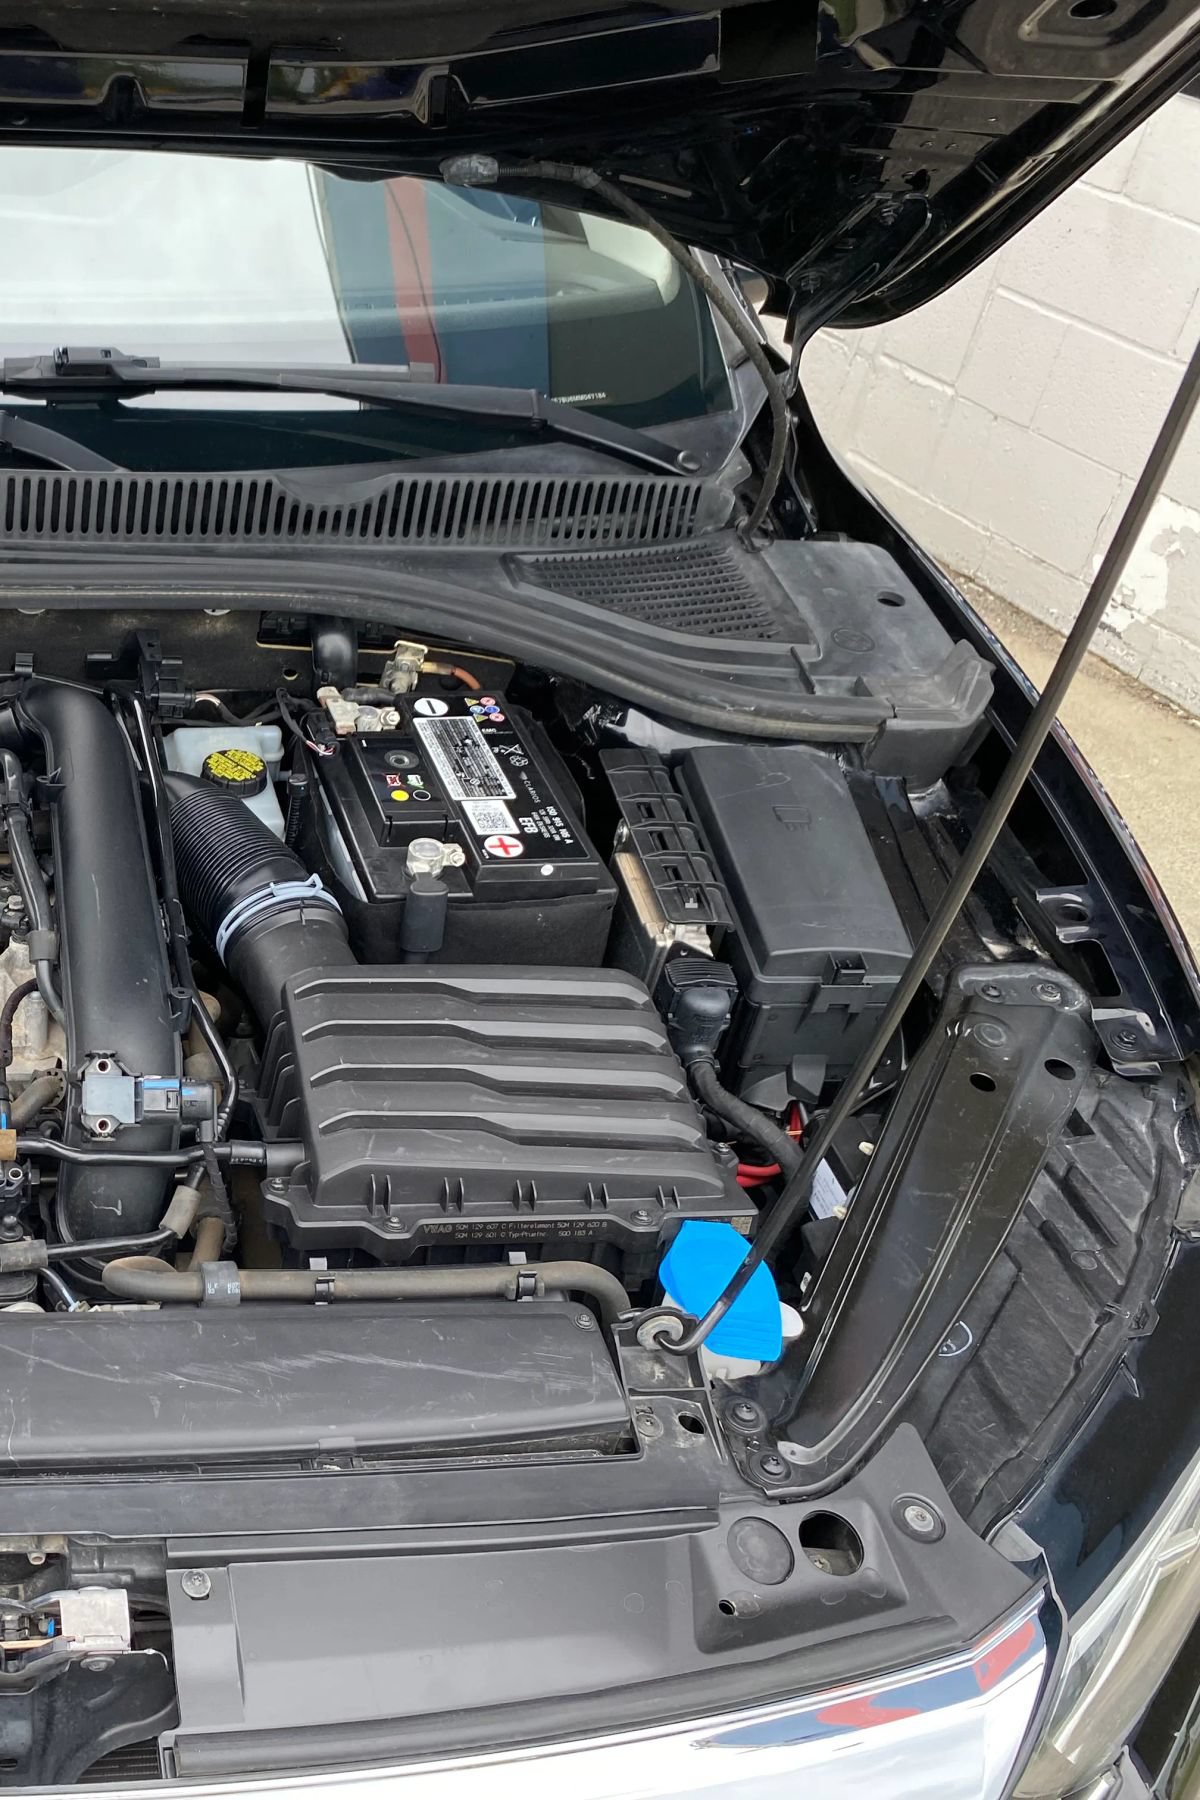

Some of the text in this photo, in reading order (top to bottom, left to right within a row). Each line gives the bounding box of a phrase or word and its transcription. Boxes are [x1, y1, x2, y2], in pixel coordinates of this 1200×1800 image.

[524, 780, 541, 803] CLARIOS
[518, 817, 539, 833] EFB
[509, 1222, 555, 1230] Filterelement
[471, 1231, 483, 1239] 129
